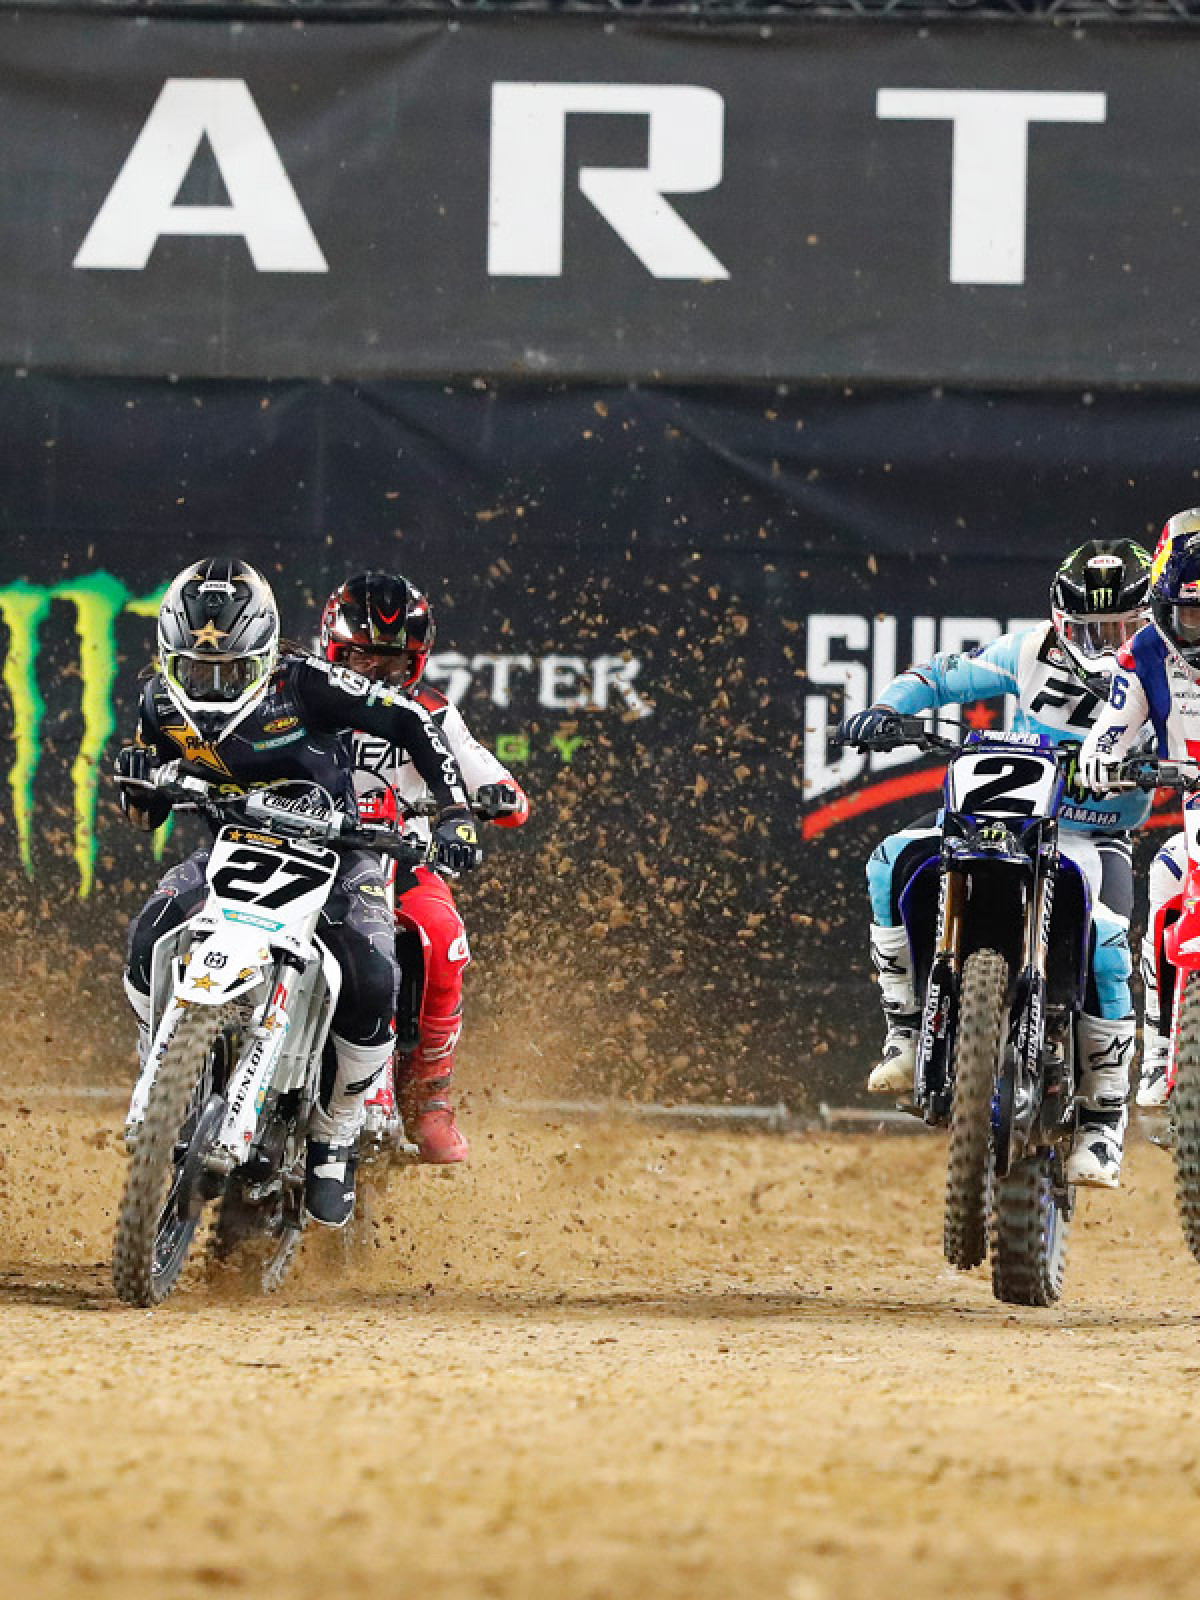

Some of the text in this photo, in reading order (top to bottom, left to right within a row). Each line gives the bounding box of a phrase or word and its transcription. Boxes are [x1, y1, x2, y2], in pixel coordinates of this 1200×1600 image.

[72, 77, 1108, 287] ART
[962, 757, 1045, 817] 2
[212, 849, 332, 909] 27
[231, 1040, 265, 1116] DUNLOP
